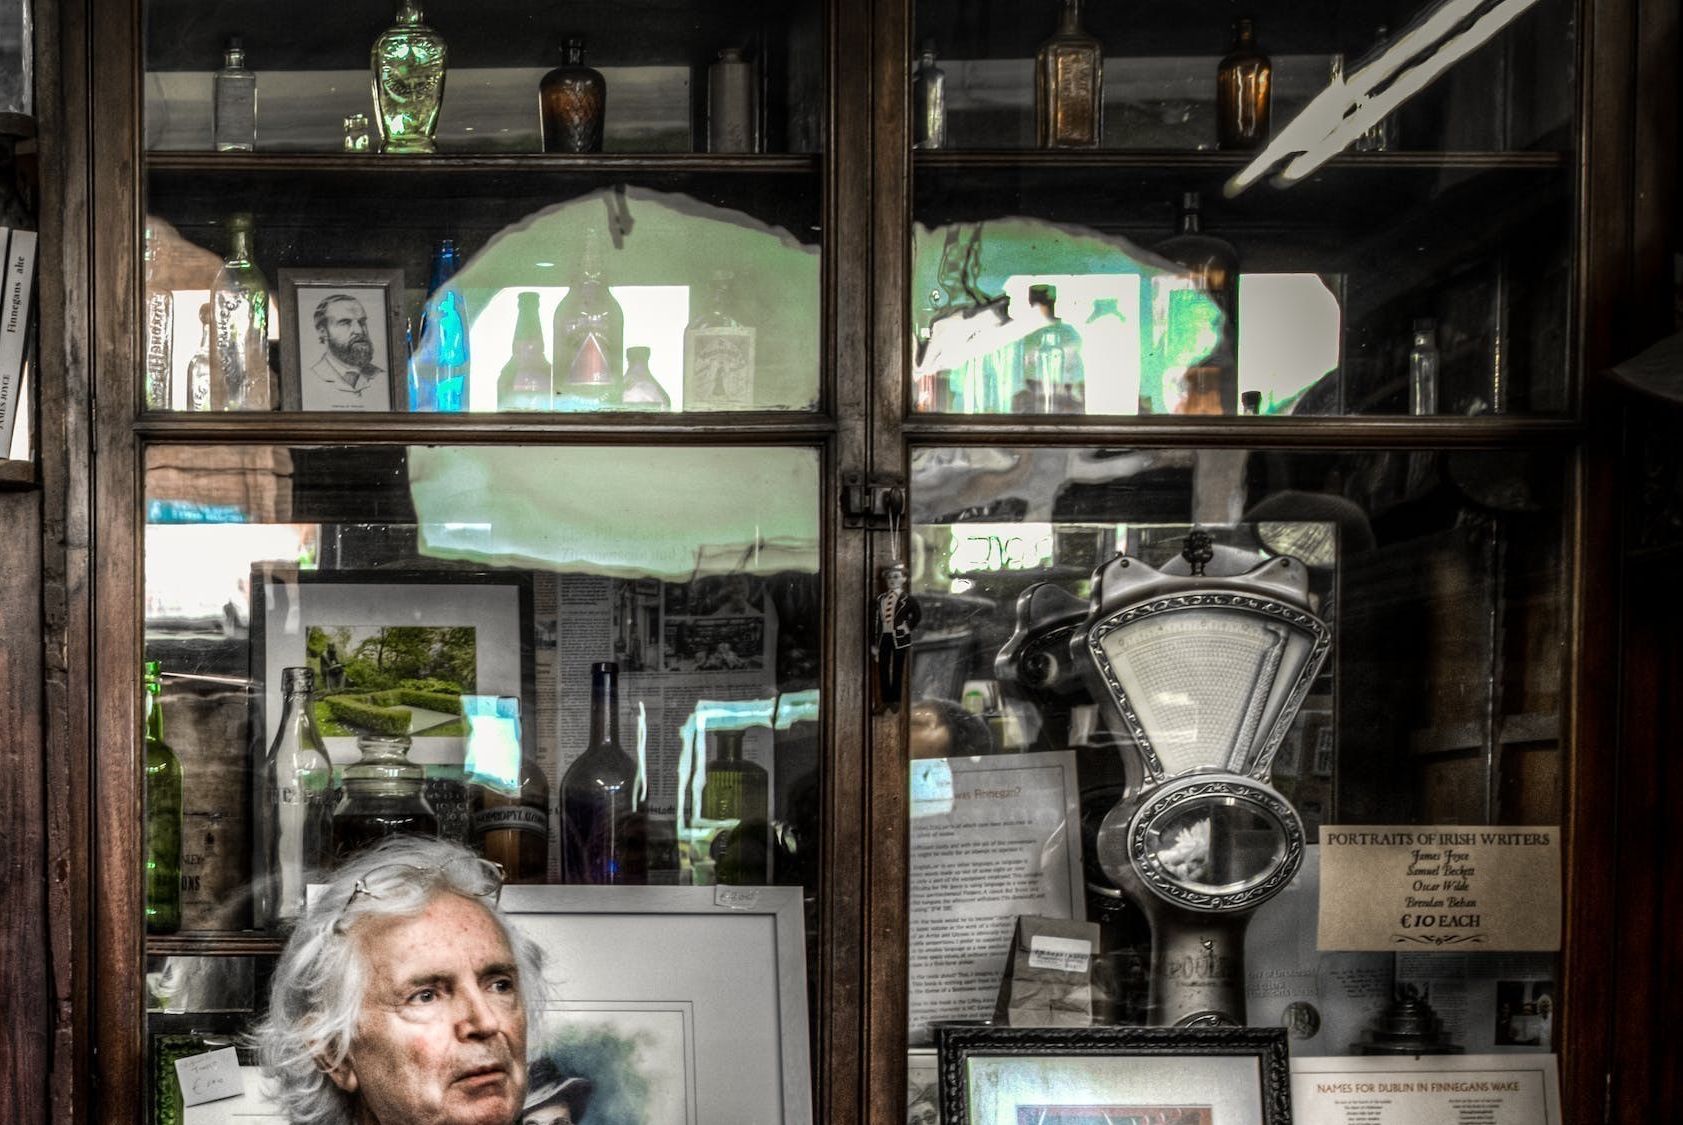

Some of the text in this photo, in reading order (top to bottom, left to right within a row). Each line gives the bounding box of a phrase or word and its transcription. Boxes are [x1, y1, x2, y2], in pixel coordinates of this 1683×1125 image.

[6, 281, 22, 334] Finnegans
[0, 374, 11, 402] JOYCE
[1327, 833, 1551, 846] PORTRAITS OF IRISH WRITERS
[1411, 850, 1470, 865] James Joyce
[1406, 865, 1439, 877] Samuel
[1412, 880, 1470, 892] Oscar Wilde
[1404, 896, 1477, 908] Brendan Behan
[1439, 914, 1481, 928] EACH
[1317, 1081, 1520, 1094] NAMES FOR DUBLIN IN FINNEGANS WAKE
